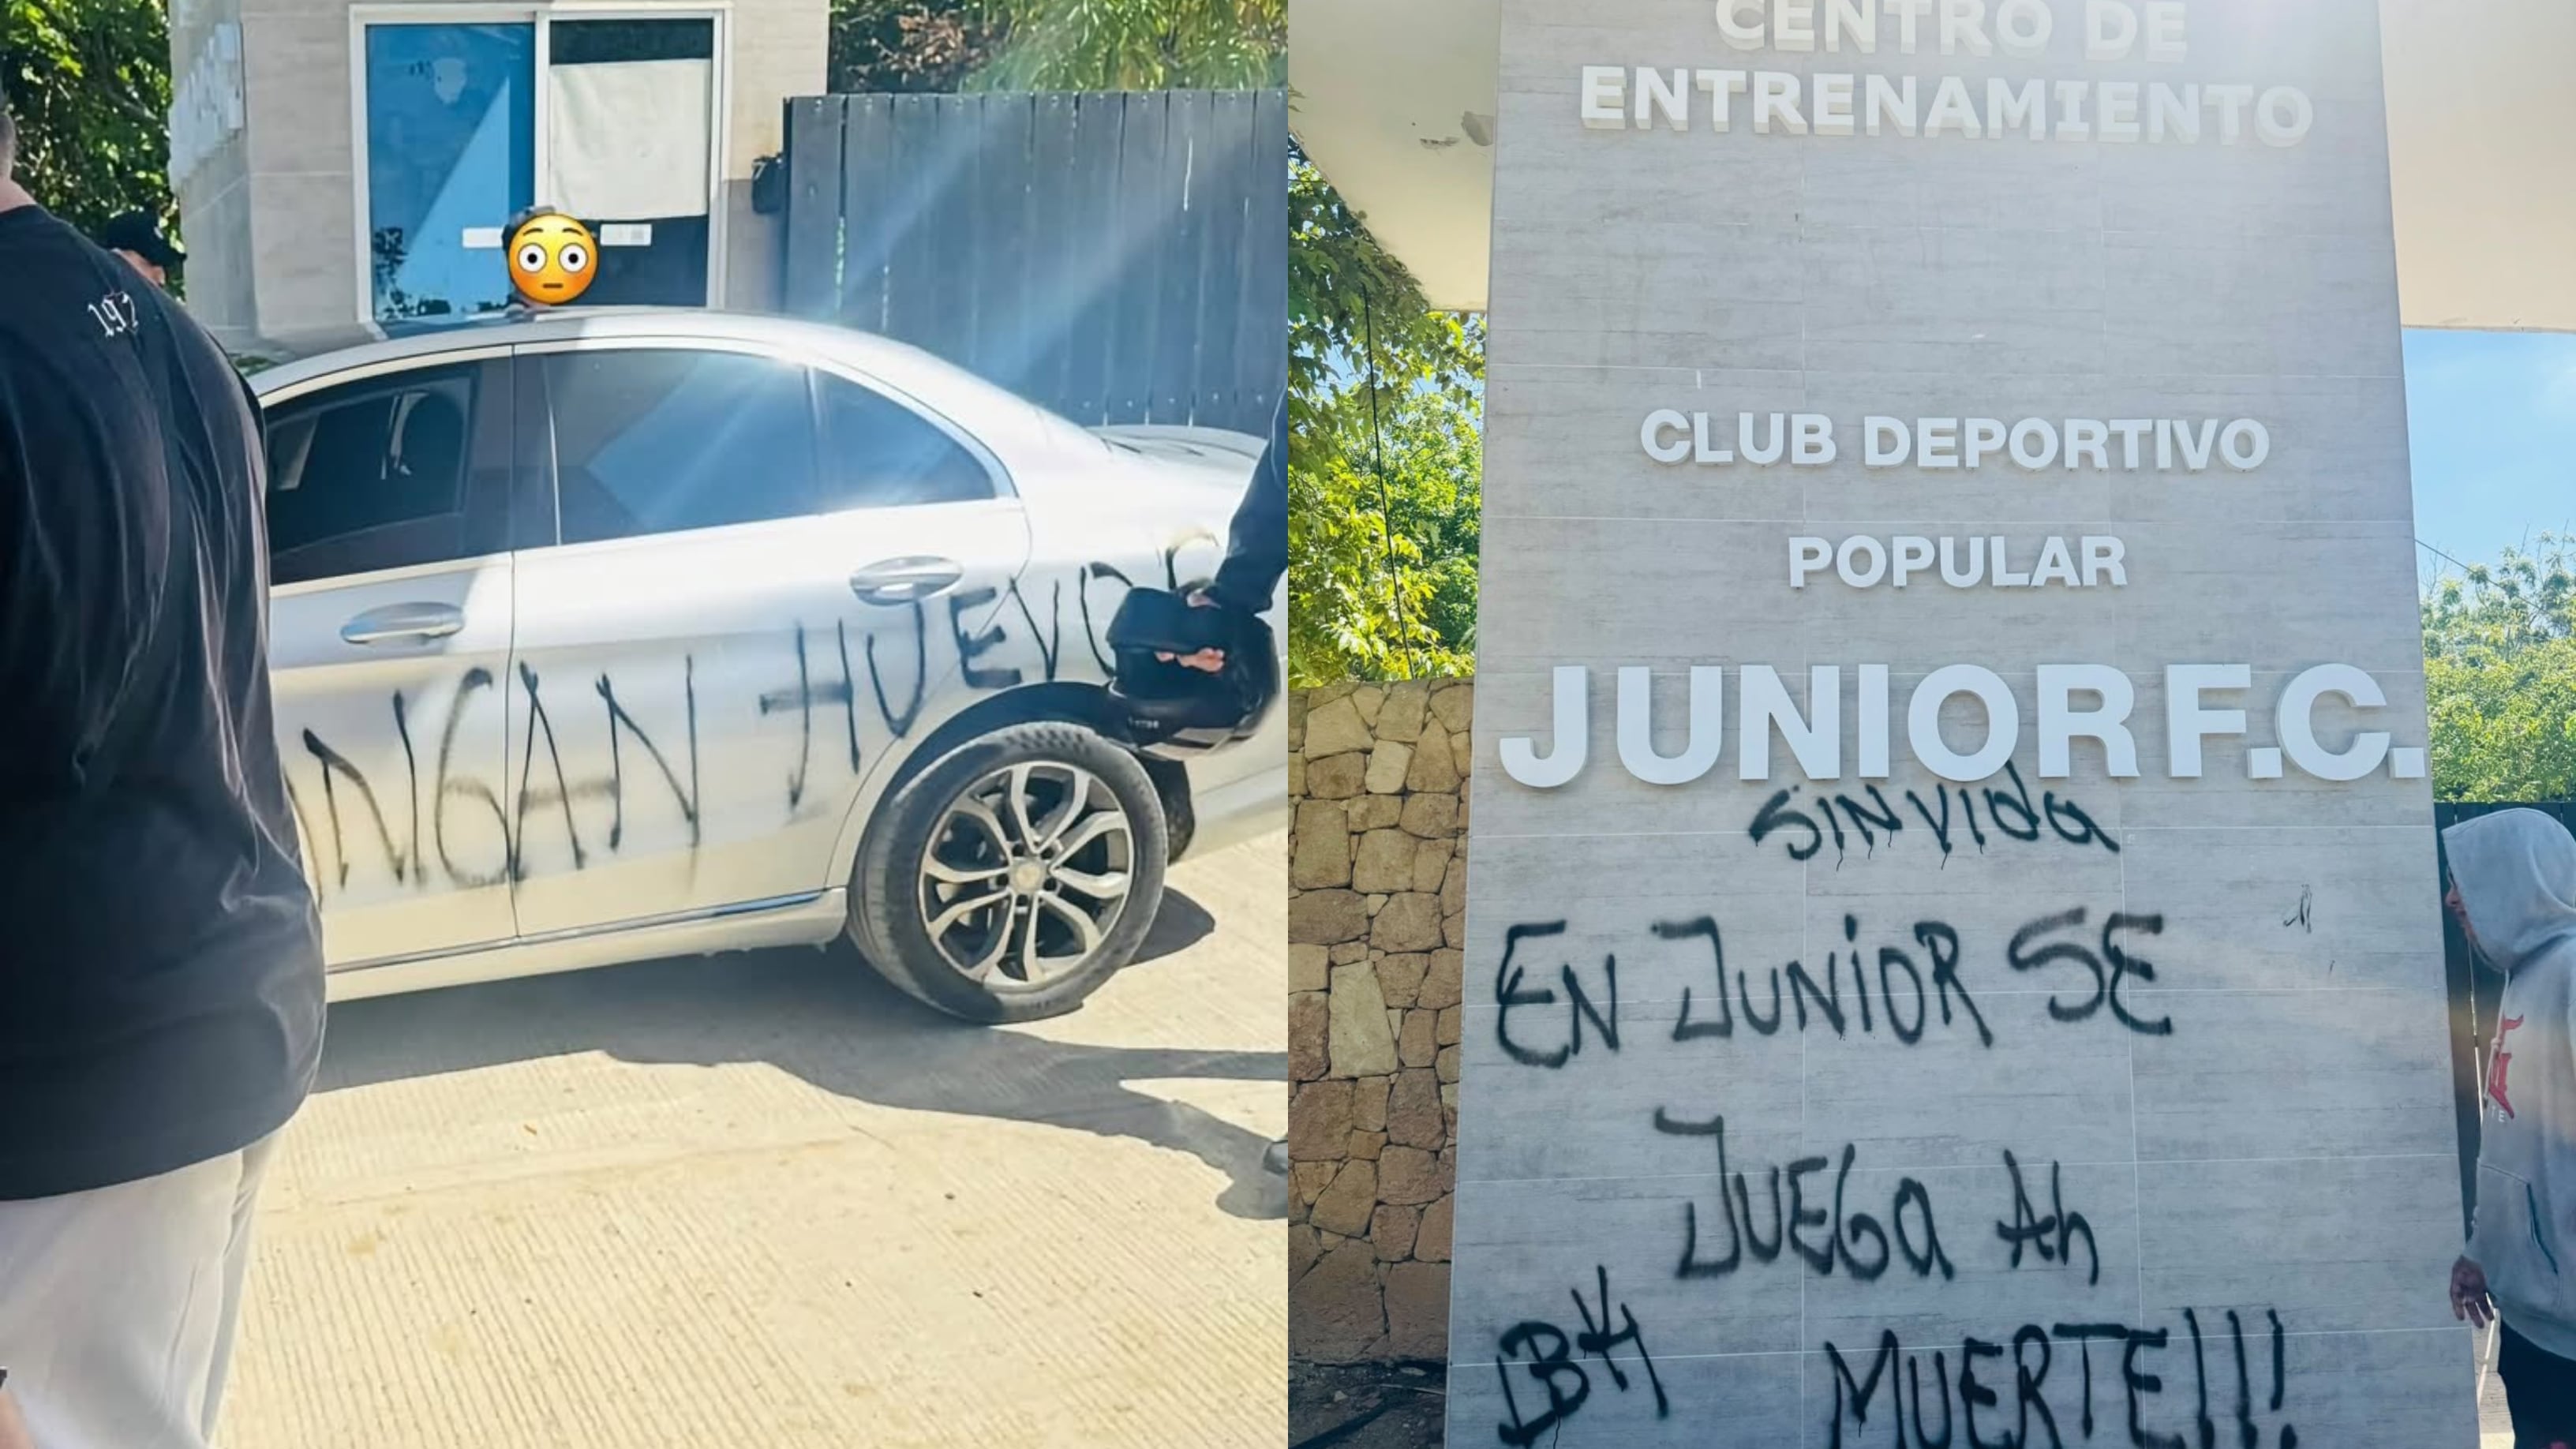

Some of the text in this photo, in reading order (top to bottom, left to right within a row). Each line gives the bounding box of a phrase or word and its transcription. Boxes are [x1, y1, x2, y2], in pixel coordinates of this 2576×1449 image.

[1715, 0, 2189, 63] CENTRO DE
[1580, 65, 2314, 148] ENTRENAMIENTO
[1640, 408, 2272, 473] CLUB DEPORTIVO
[1788, 534, 2129, 590] POPULAR
[1498, 663, 2427, 788] JUNIOR F.C.
[283, 653, 701, 909] NGAN
[1496, 918, 1620, 1069] EN
[2007, 905, 2174, 1036] SE
